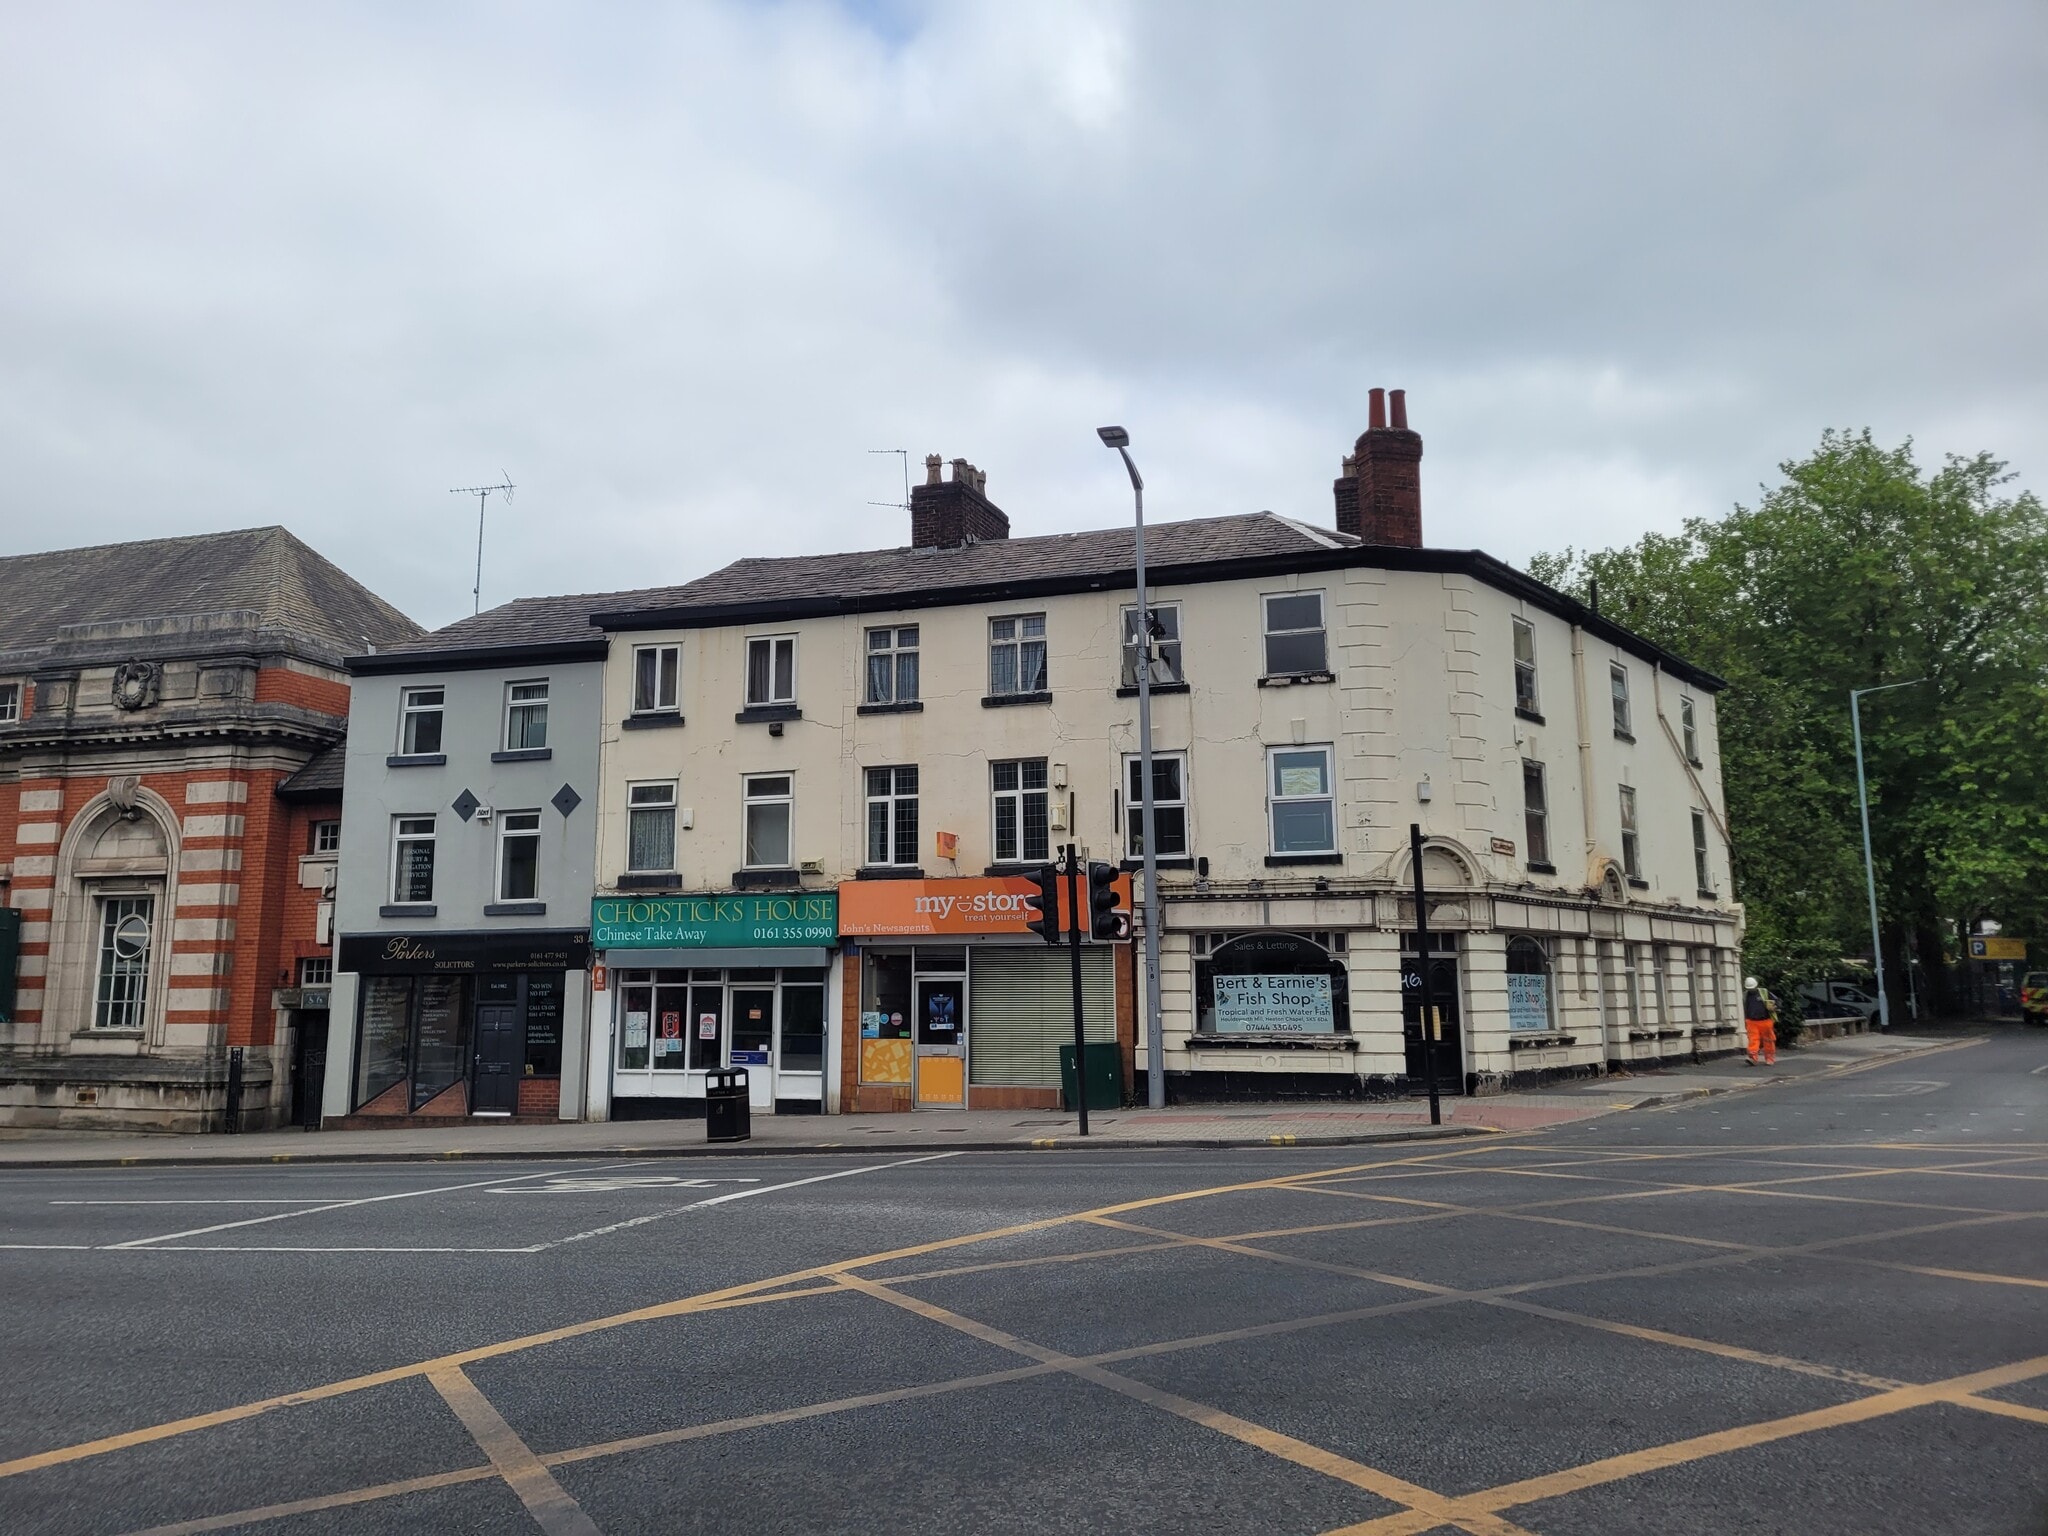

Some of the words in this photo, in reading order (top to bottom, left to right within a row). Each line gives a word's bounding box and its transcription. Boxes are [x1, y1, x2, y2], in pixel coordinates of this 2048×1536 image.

[597, 899, 743, 924] CHOPSTICKS
[754, 898, 833, 922] HOUSE
[914, 895, 956, 920] my
[964, 912, 987, 922] treat
[989, 911, 1029, 923] yourself
[840, 923, 871, 934] John's
[873, 922, 930, 934] Newsagents
[573, 935, 584, 944] 33
[596, 926, 642, 942] Chinese
[644, 926, 673, 941] Take
[674, 925, 707, 944] Away
[753, 926, 780, 940] 0161
[782, 926, 802, 939] 355
[804, 926, 832, 939] 0990
[381, 936, 436, 960] Parkers
[1234, 941, 1255, 951] Sales
[1256, 941, 1264, 950] &
[1266, 941, 1299, 951] Lettings
[434, 960, 475, 969] SOLICITORS
[1216, 977, 1248, 989] Bert
[1252, 976, 1262, 989] &
[1268, 976, 1328, 989] Earnie's
[1507, 976, 1517, 988] ert
[1237, 992, 1267, 1005] Fish
[1272, 992, 1311, 1008] Shop
[1512, 990, 1524, 1004] Fish
[1525, 990, 1540, 1006] Shop
[1217, 1008, 1248, 1017] Tropical
[1250, 1008, 1264, 1016] and
[1266, 1008, 1288, 1016] Fresh
[1289, 1008, 1312, 1016] Water
[1314, 1008, 1331, 1016] Fish
